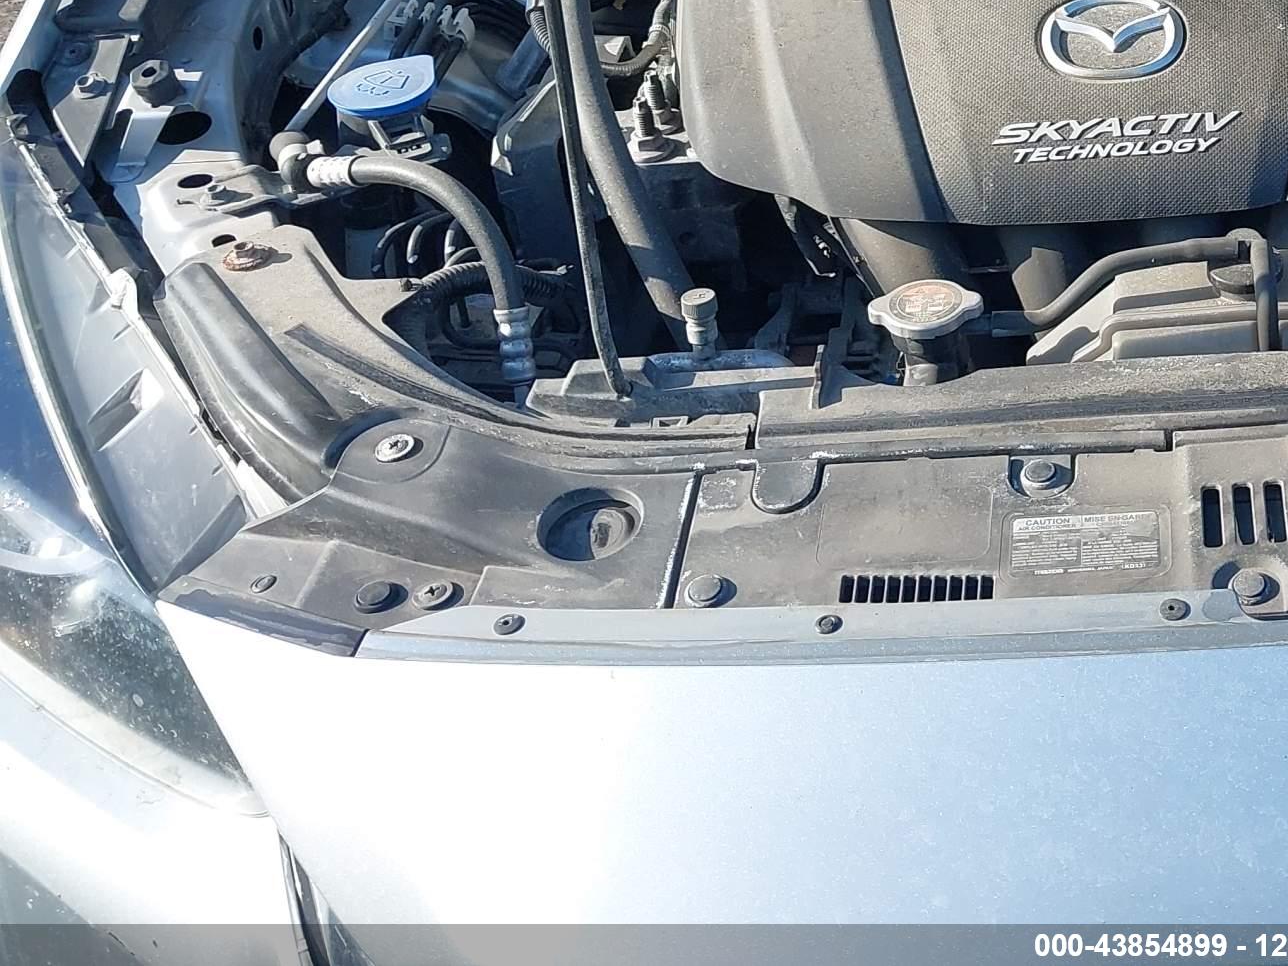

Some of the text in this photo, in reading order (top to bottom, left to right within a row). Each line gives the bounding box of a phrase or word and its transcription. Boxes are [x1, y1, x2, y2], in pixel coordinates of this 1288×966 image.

[992, 111, 1243, 145] SKYACTIV
[1013, 138, 1221, 164] TECHNOLOGY
[1025, 517, 1070, 526] CAUTION
[1084, 515, 1106, 523] MISE
